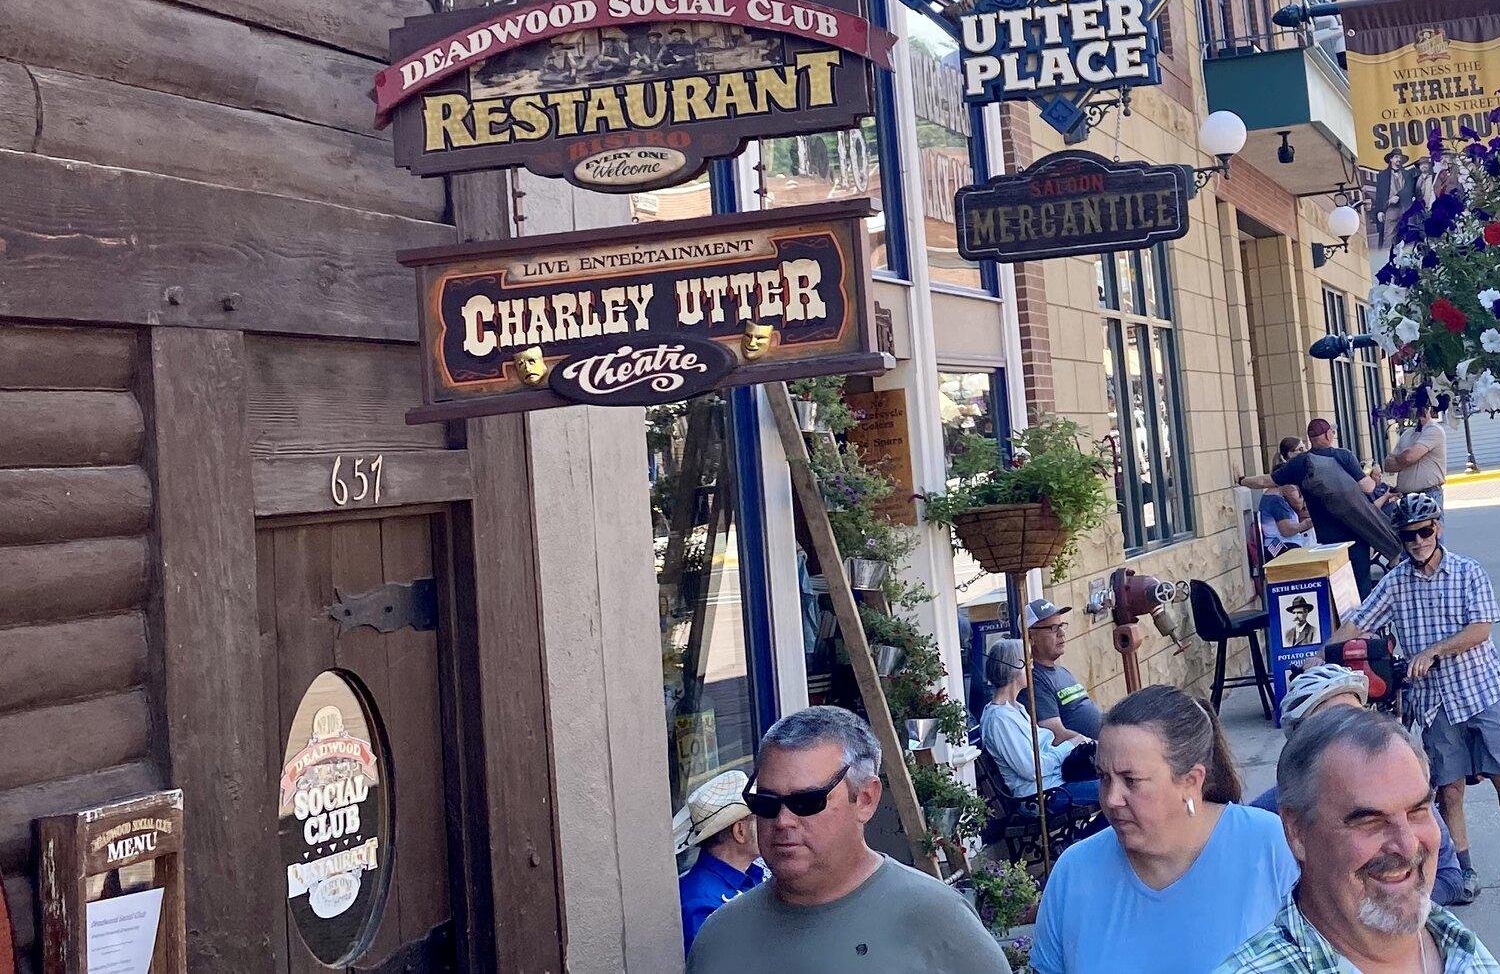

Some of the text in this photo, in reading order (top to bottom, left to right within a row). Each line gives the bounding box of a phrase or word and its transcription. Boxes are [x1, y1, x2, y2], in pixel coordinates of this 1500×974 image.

[964, 36, 1149, 96] PLACE
[1393, 60, 1483, 80] WITNESS THE
[423, 50, 841, 151] RESTAURANT
[1393, 74, 1484, 104] THRILL
[1381, 96, 1500, 120] OF A MAIN STREET
[585, 150, 669, 170] EVERY ONE
[592, 160, 662, 179] Welcome
[1028, 176, 1105, 198] SALOON
[970, 189, 1173, 246] MERCANTILE
[523, 239, 754, 278] LIVE ENTERTAINMENT
[461, 257, 827, 357] CHARLEY UTTER
[562, 344, 707, 394] Theatre
[331, 455, 383, 505] 657
[1271, 582, 1322, 593] SETH BULLOCK
[1278, 652, 1304, 661] POTATO
[294, 741, 362, 774] DEADWOOD
[293, 775, 369, 821] SOCIAL
[303, 804, 361, 846] CLUB
[107, 831, 158, 863] MENU
